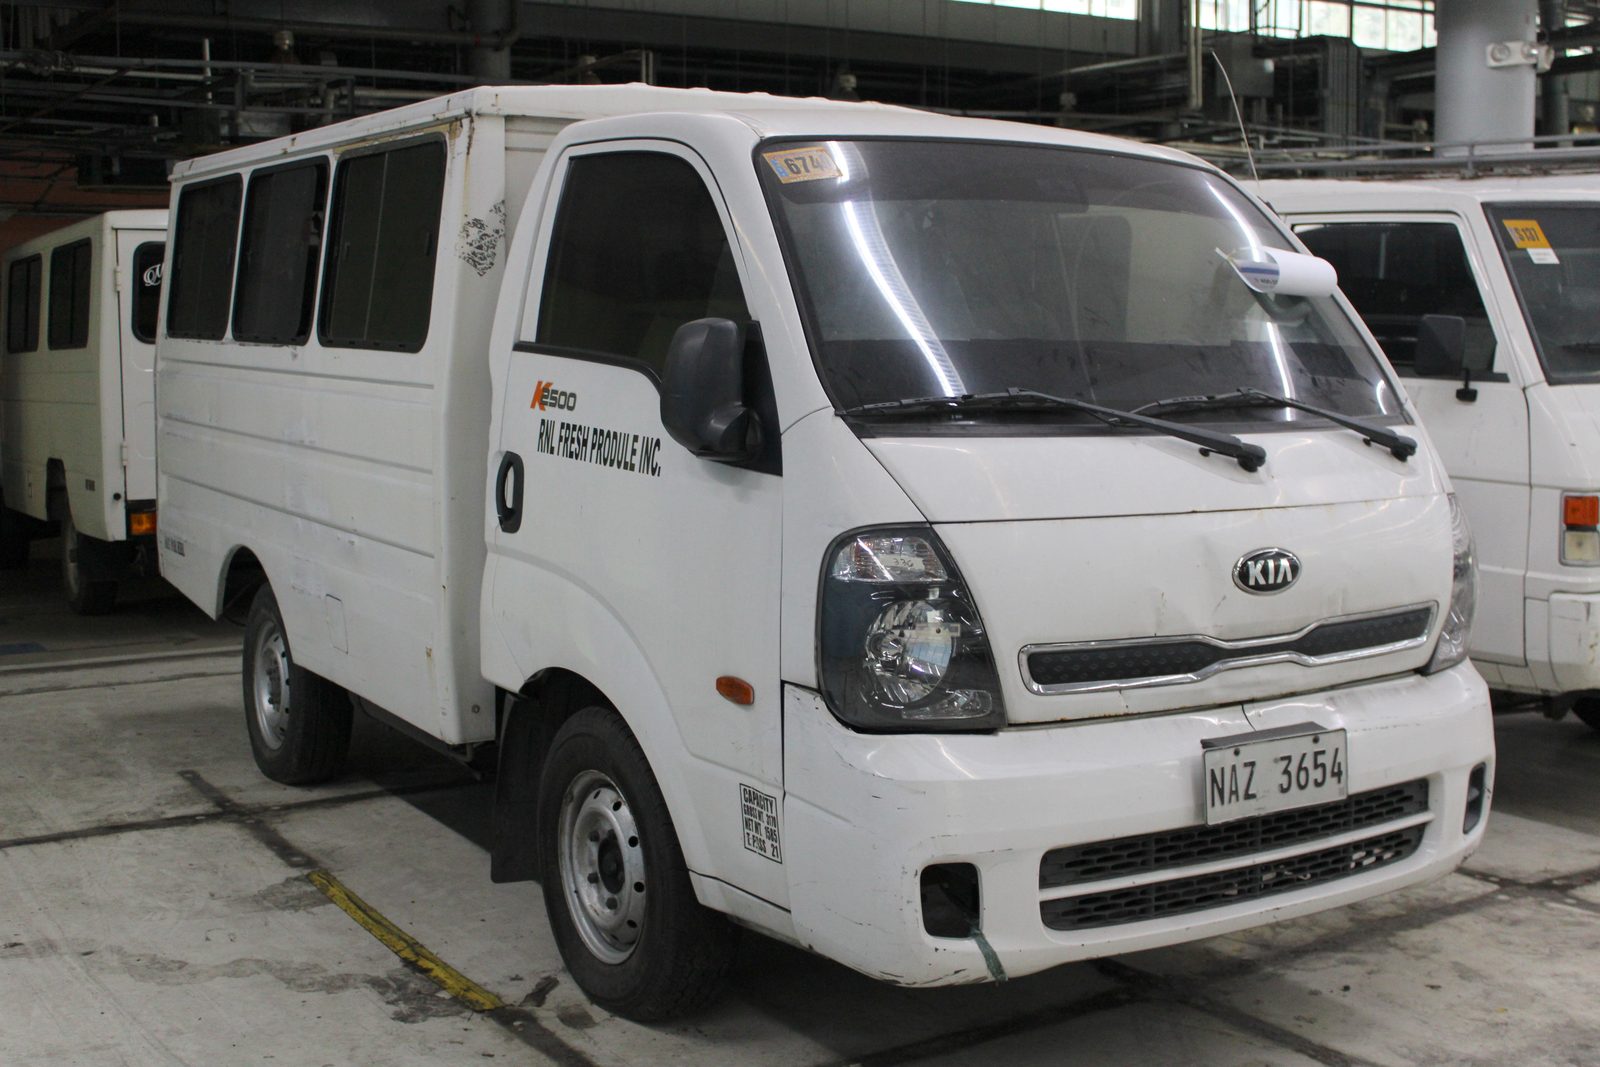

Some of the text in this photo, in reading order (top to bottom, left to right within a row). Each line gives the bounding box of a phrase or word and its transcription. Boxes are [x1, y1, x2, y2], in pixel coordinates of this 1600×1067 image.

[530, 380, 577, 411] K2500
[537, 418, 556, 455] RNL
[556, 421, 590, 462] FRESH
[638, 435, 662, 477] INC.
[1247, 557, 1293, 586] KIA
[1210, 747, 1343, 808] NAZ 3654
[743, 787, 774, 814] CAPACITY
